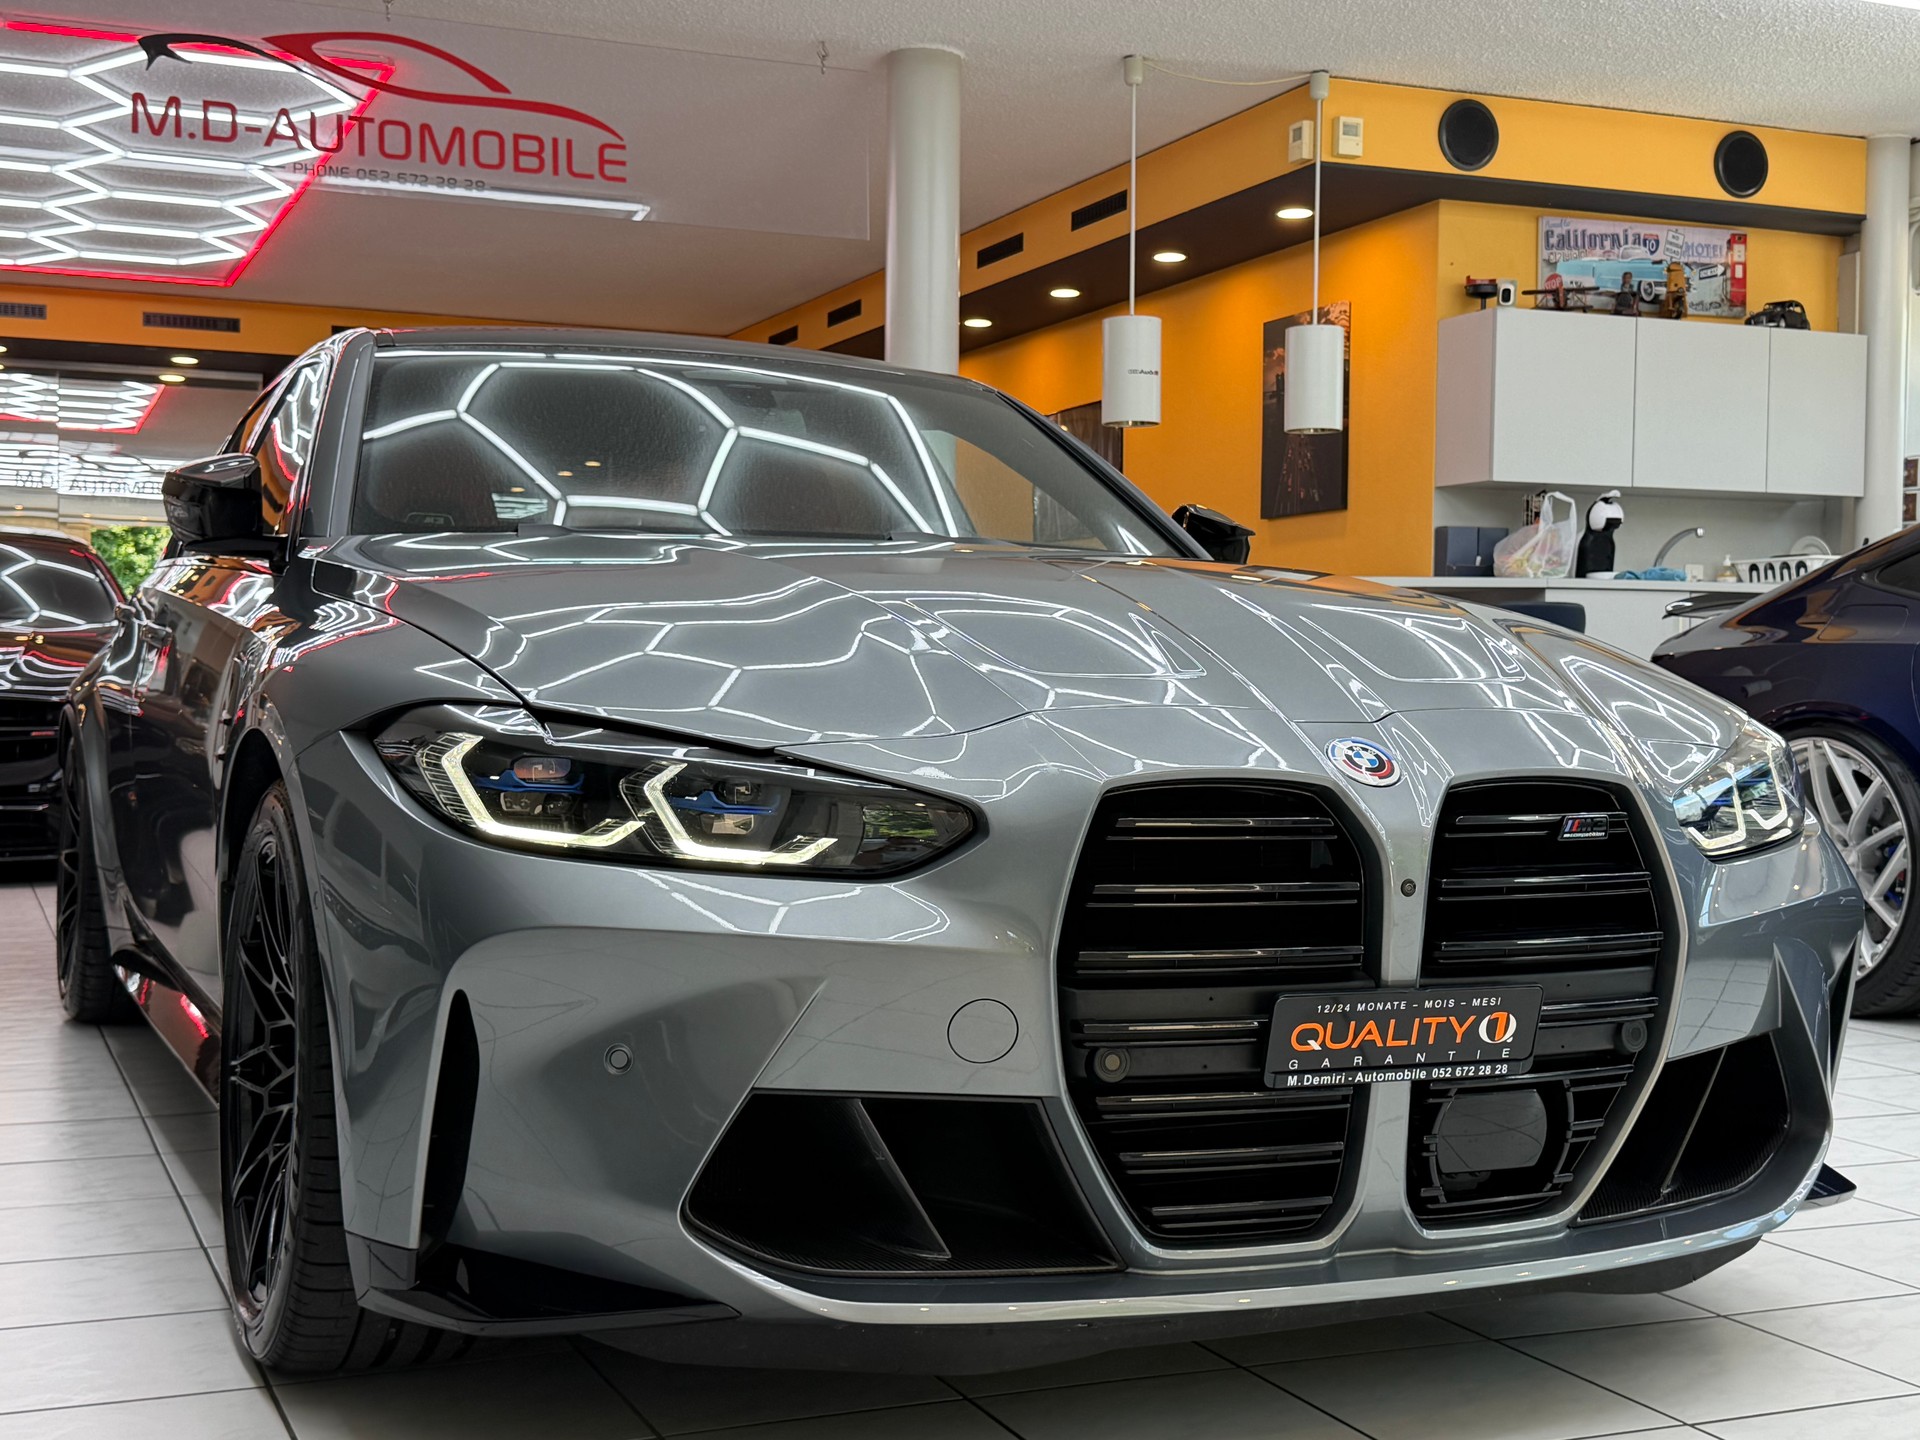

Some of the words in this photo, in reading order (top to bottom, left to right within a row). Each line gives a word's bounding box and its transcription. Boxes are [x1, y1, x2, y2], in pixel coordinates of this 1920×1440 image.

[131, 92, 627, 183] M.D-AUTOMOBILE
[293, 162, 350, 178] PHONE
[356, 168, 390, 182] 052
[1544, 229, 1641, 251] California
[1646, 239, 1656, 251] 10
[1317, 1003, 1351, 1014] 12/24
[1356, 1001, 1407, 1012] MONATE
[1424, 998, 1455, 1009] MOIS
[1471, 996, 1501, 1007] MESI
[1290, 1014, 1477, 1051] QUALITY
[1431, 1067, 1452, 1079] 052
[1455, 1065, 1475, 1077] 672
[1478, 1064, 1492, 1075] 28
[1494, 1063, 1508, 1075] 28
